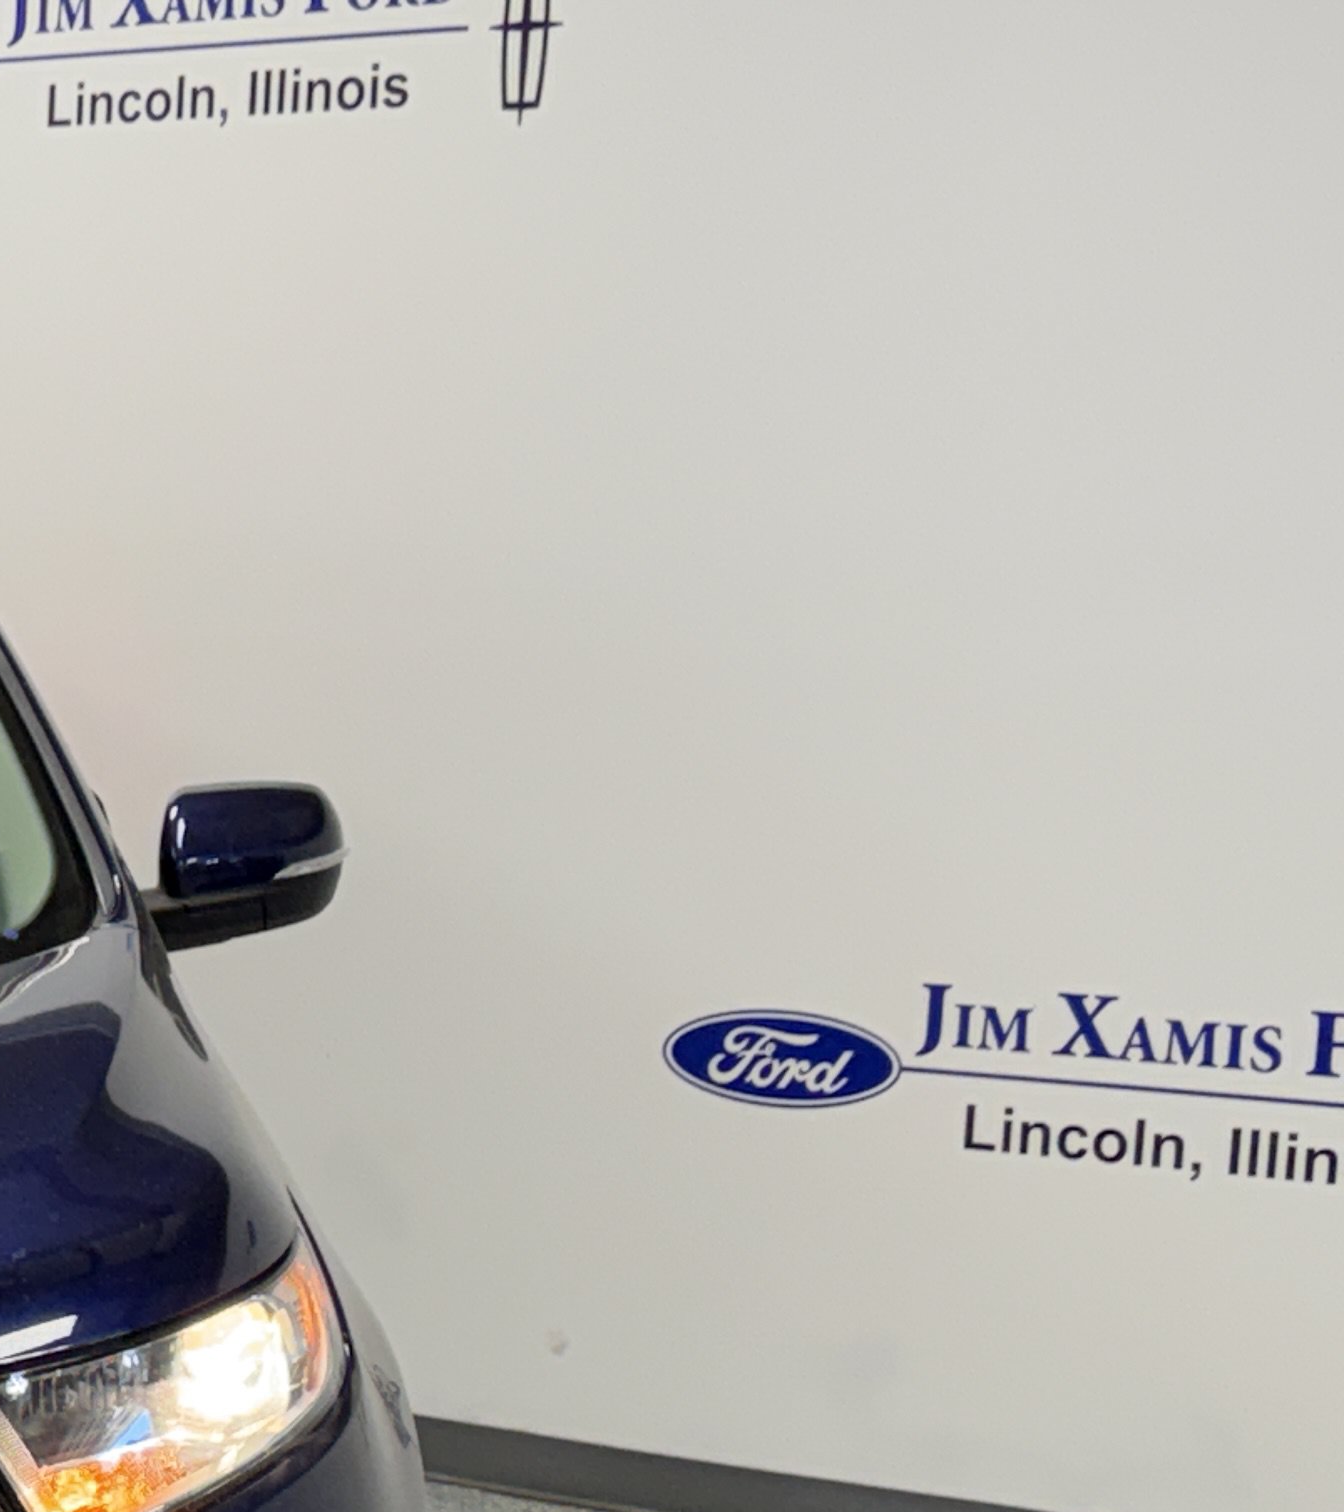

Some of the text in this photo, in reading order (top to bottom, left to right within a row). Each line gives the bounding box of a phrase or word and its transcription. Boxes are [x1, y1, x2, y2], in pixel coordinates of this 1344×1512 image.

[47, 62, 410, 128] Lincoln, Illinois
[707, 1024, 855, 1095] Ford
[915, 983, 1035, 1057] JIM
[1051, 991, 1283, 1074] XAMIS
[963, 1103, 1202, 1182] Lincoln,
